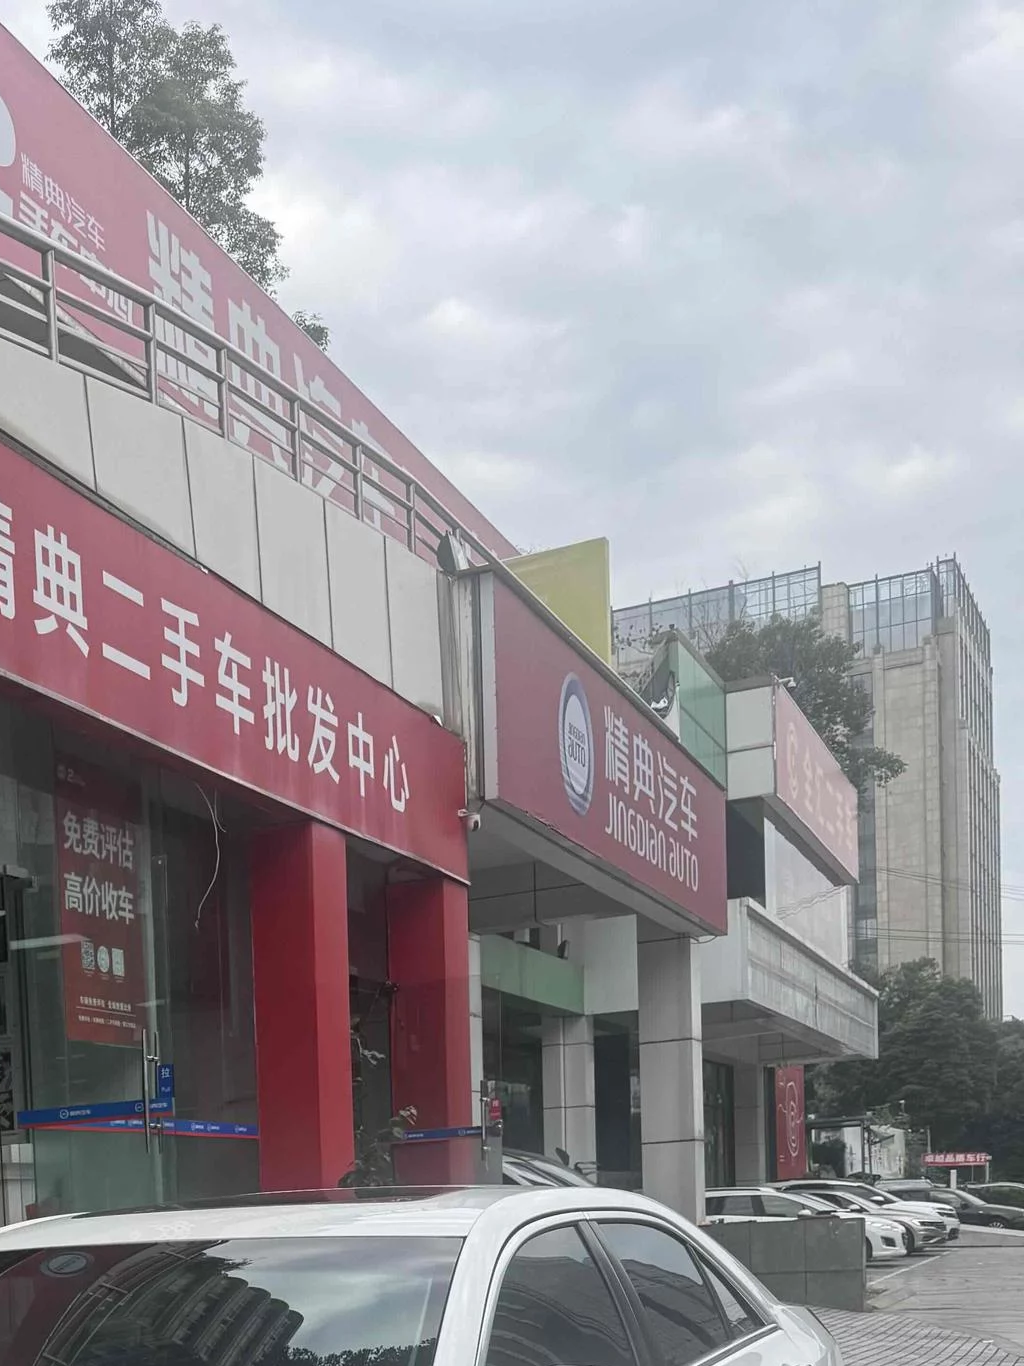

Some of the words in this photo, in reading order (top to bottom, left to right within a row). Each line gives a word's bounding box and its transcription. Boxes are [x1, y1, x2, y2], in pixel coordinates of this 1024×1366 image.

[20, 152, 106, 252] 精典汽车
[603, 705, 699, 842] 精典汽车
[63, 811, 134, 870] 免费评估
[64, 872, 135, 925] 高价收车
